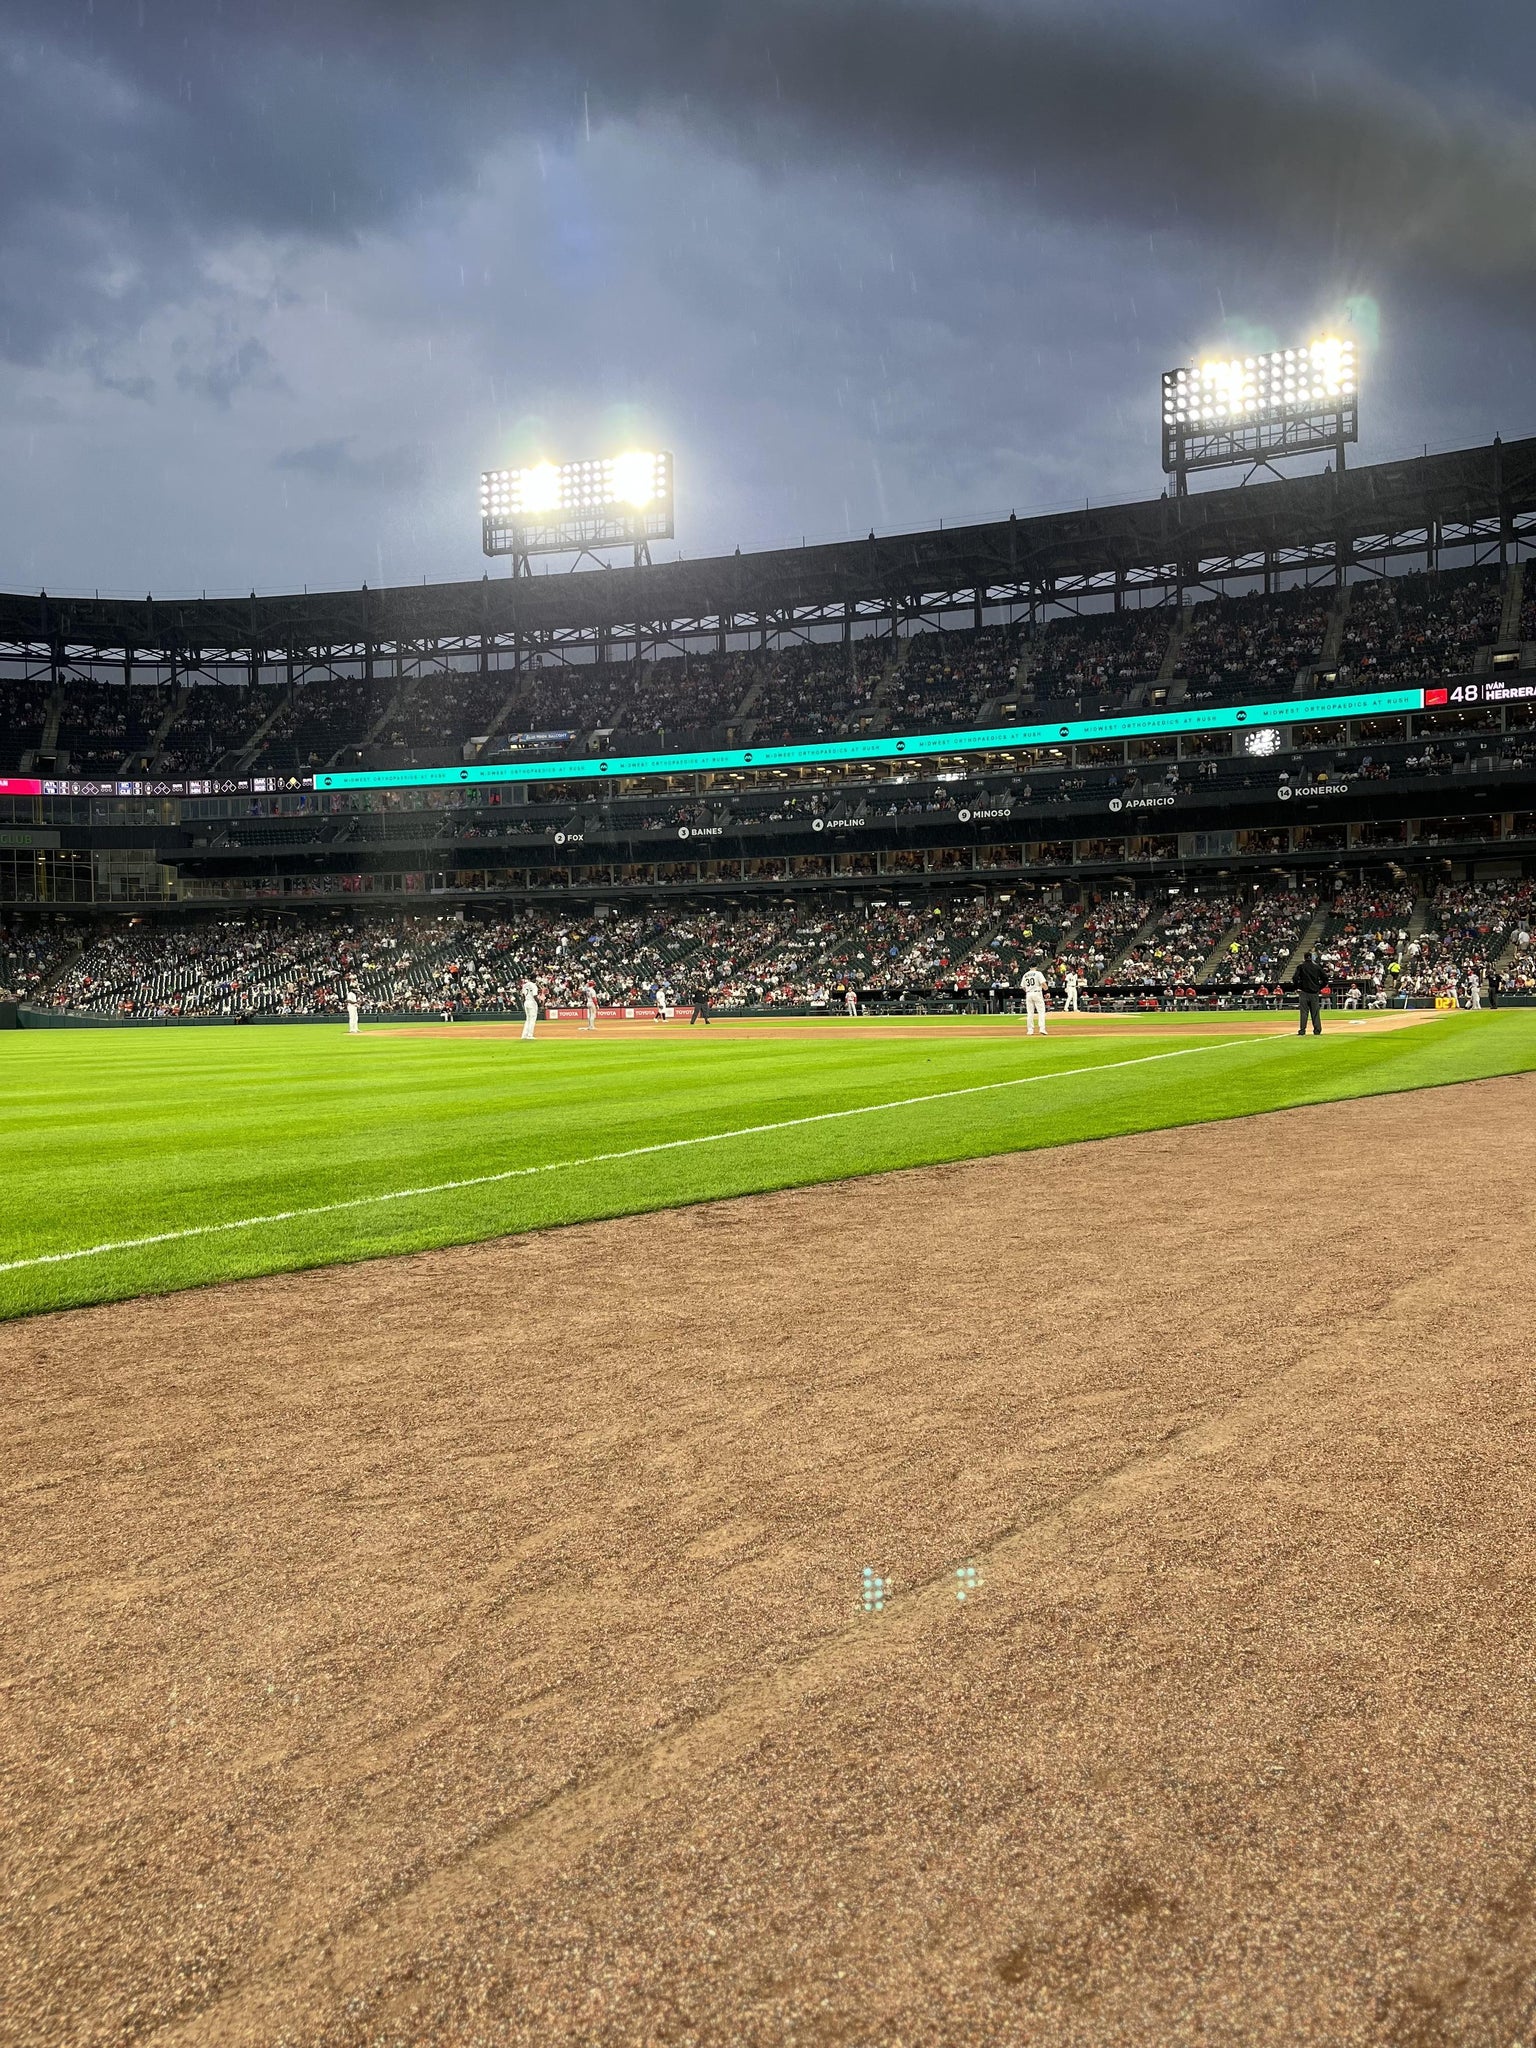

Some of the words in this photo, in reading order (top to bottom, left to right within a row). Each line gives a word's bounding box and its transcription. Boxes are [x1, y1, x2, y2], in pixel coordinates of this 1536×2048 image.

[1485, 681, 1505, 690] IVÁN
[1450, 685, 1478, 702] 48
[1263, 707, 1299, 716] MIDWEST
[1305, 701, 1367, 712] ORTHOPAEDICS
[1084, 724, 1117, 732] MIDWEST
[1122, 719, 1179, 729] ORTHOPAEDICS
[954, 735, 1007, 743] ORTHOPAEDICS
[800, 748, 848, 757] ORTHOPAEDICS
[1280, 789, 1290, 797] 14
[1295, 785, 1348, 796] KONERKO
[1112, 801, 1120, 809] 11
[1125, 797, 1175, 808] APARICIO
[973, 809, 1011, 819] MINOSO
[815, 821, 821, 829] 4
[826, 818, 865, 828] APPLING
[691, 827, 723, 836] BAINES
[1025, 977, 1036, 987] 30
